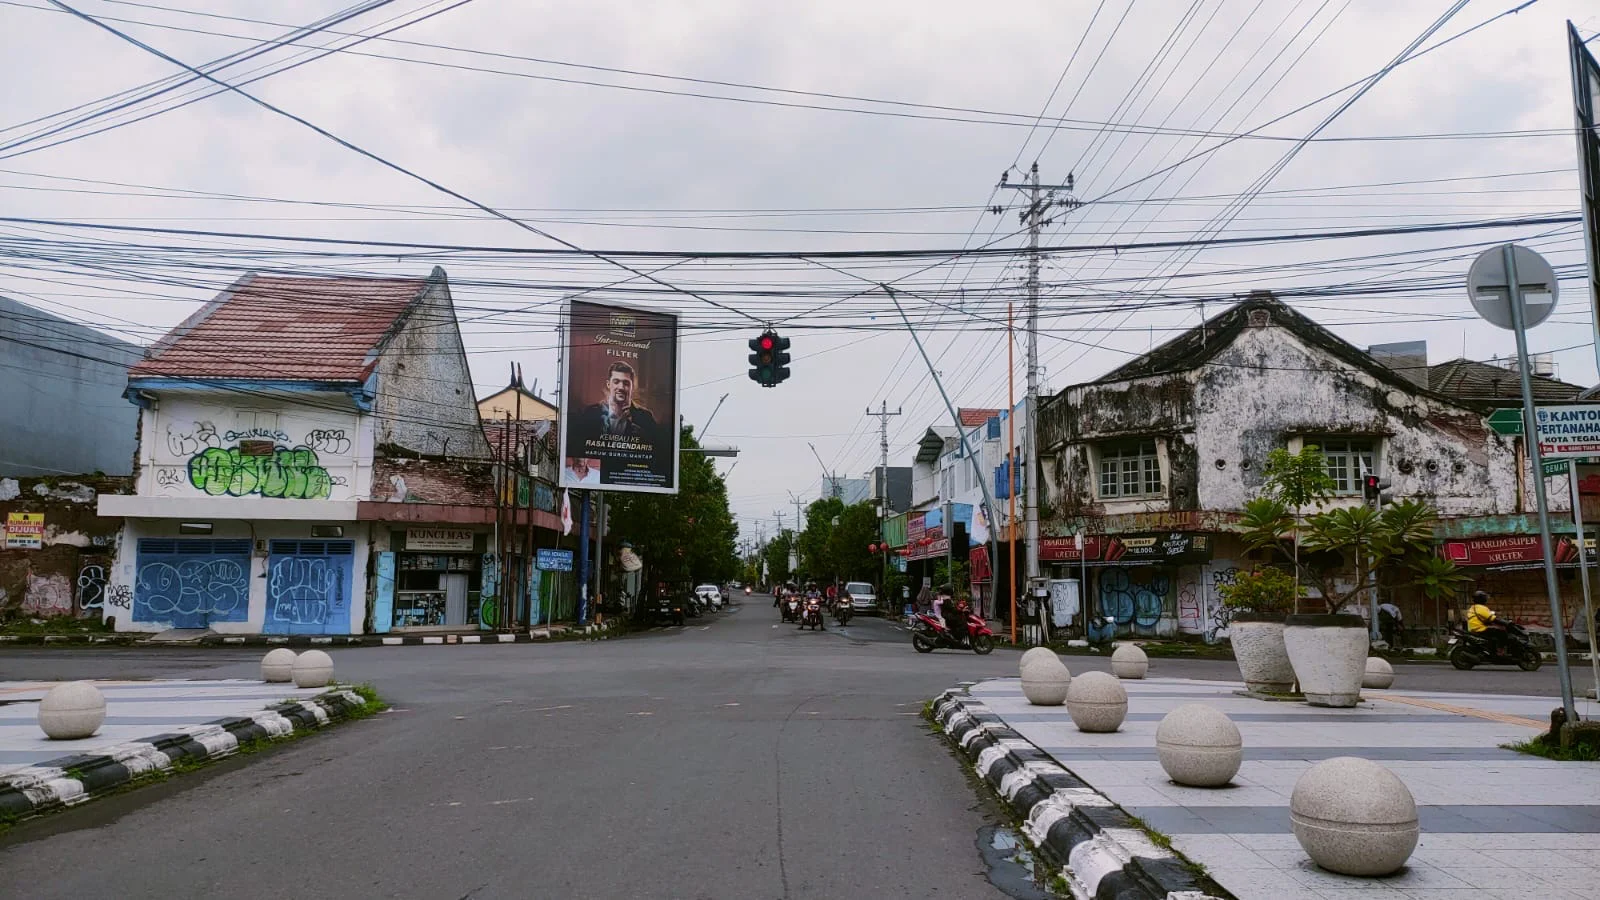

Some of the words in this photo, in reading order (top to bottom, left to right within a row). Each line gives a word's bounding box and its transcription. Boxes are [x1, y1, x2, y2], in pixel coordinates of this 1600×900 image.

[606, 348, 639, 359] FILTER
[600, 433, 629, 443] KEMBALI
[630, 435, 641, 444] KE
[585, 439, 606, 448] RASA
[607, 441, 653, 451] LEGENDARIS
[409, 529, 445, 539] KUNCI
[447, 530, 471, 540] MAS
[1471, 539, 1508, 549] DJARUM
[1508, 537, 1537, 546] SUPER
[1055, 550, 1081, 558] KRETEK
[1489, 551, 1524, 562] KRETEK
